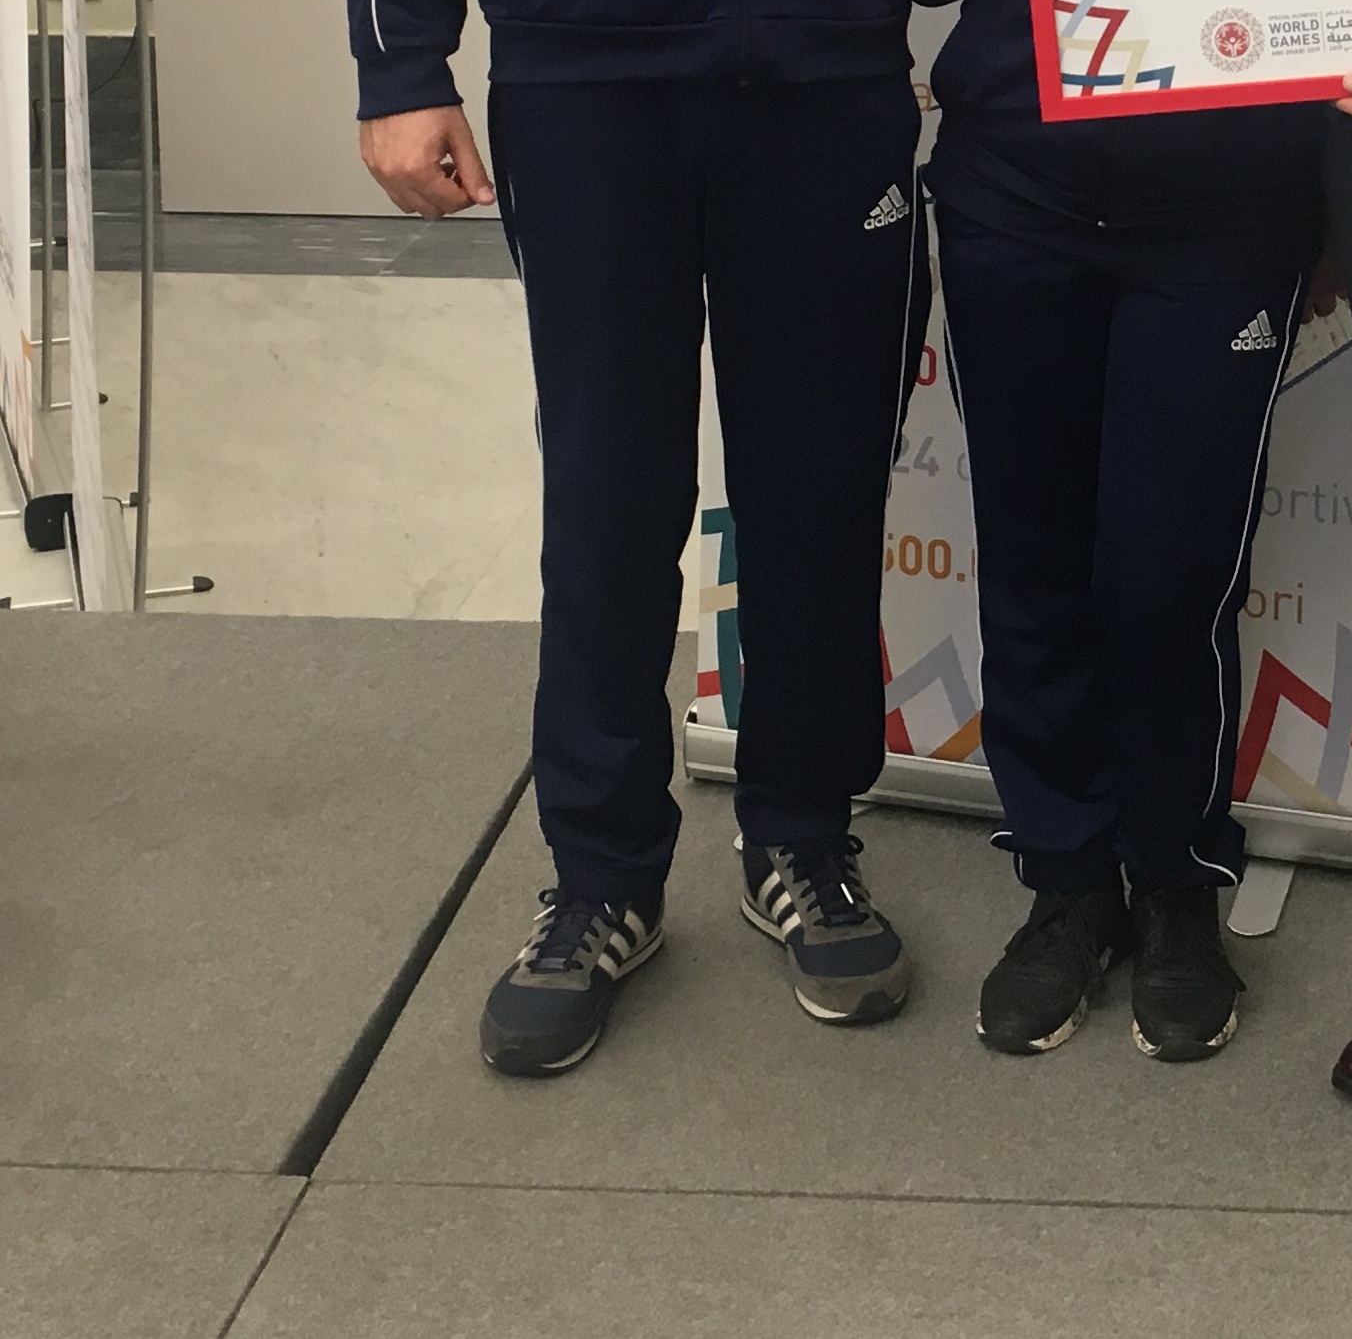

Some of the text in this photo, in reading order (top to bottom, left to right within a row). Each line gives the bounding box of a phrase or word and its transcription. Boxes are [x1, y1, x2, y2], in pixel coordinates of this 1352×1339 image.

[1268, 19, 1320, 34] WORLD
[1270, 33, 1321, 49] GAMES
[864, 202, 909, 230] adidas
[1231, 336, 1277, 351] adidas
[1244, 582, 1304, 624] ori
